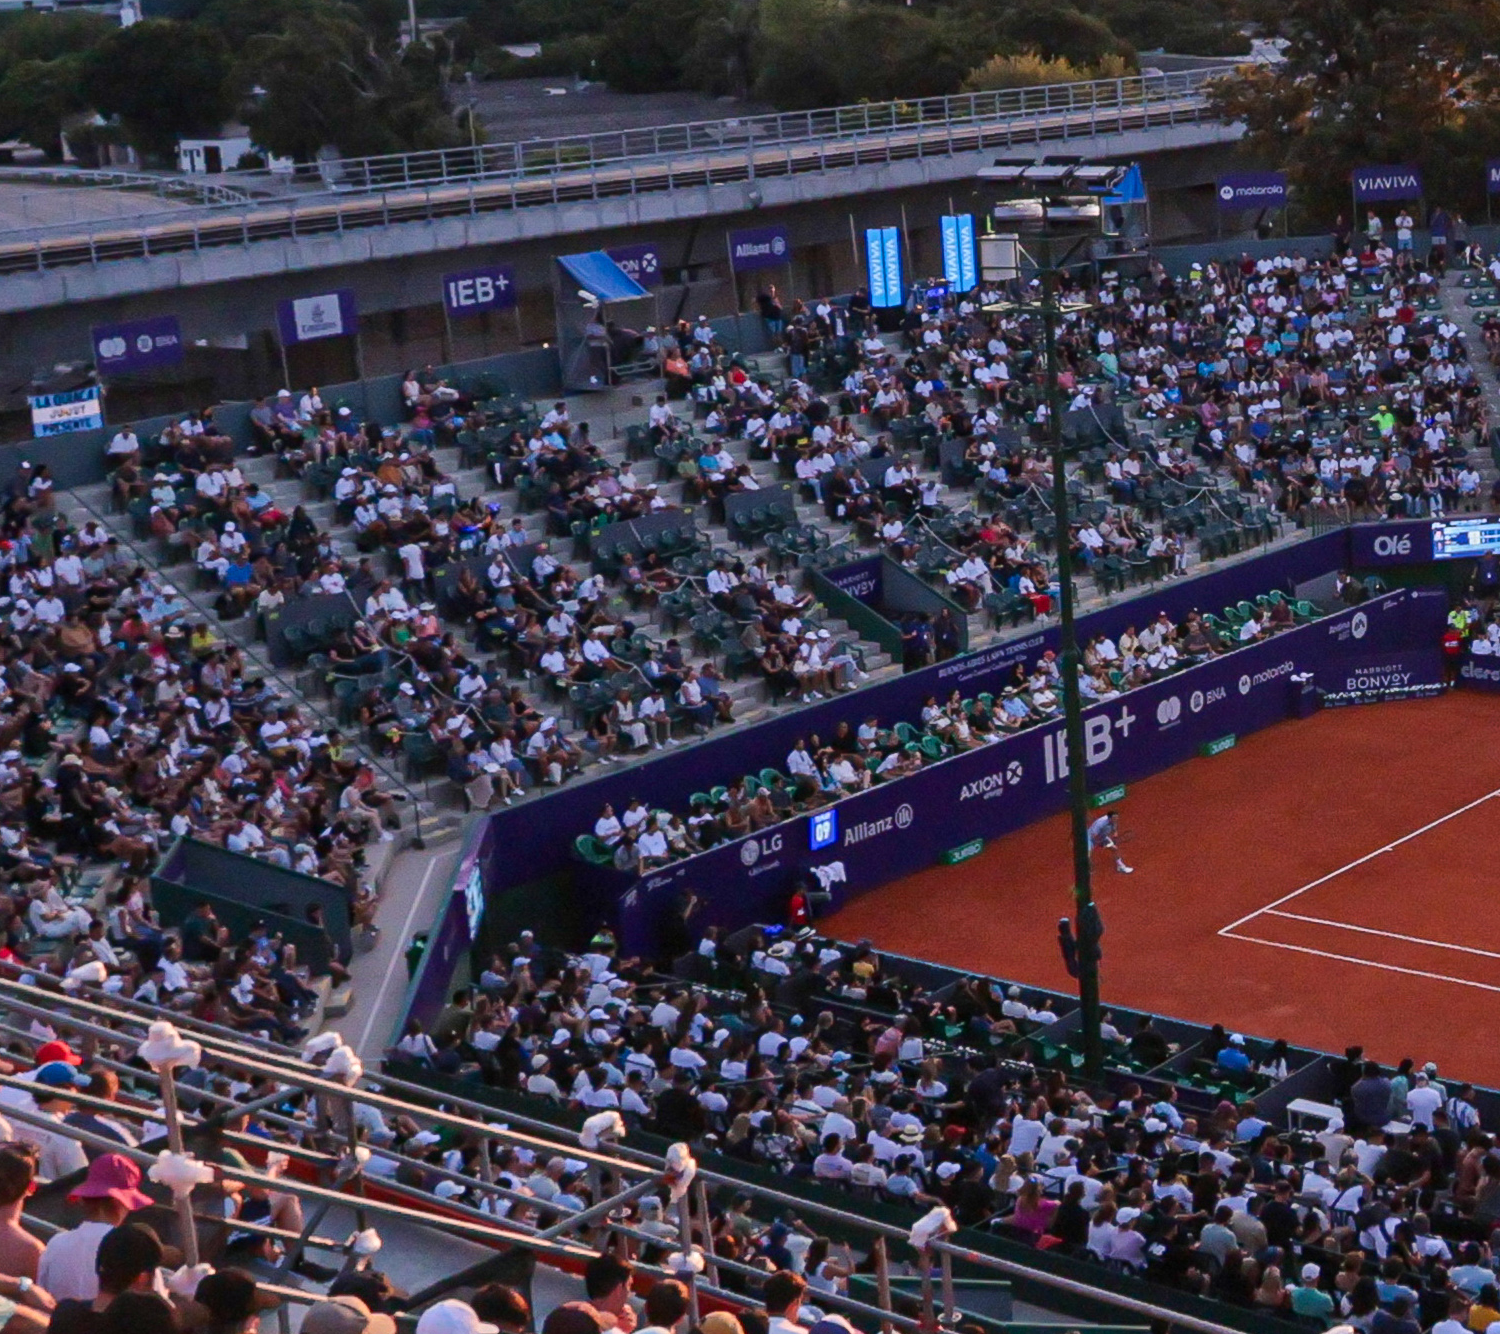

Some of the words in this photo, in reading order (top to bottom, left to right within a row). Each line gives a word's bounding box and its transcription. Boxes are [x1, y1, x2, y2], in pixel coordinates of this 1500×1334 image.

[1235, 183, 1284, 197] motorola
[1358, 174, 1417, 191] VIAVIVA
[449, 274, 510, 308] IEB+
[1373, 533, 1412, 556] Olé
[844, 578, 877, 598] NVOY
[1252, 660, 1294, 687] motorola
[1354, 664, 1403, 675] MARRIOTT
[1346, 673, 1411, 691] BONVOY
[959, 771, 1003, 802] AXION
[815, 820, 831, 842] 09
[844, 816, 894, 847] Allianz
[762, 833, 784, 856] LG
